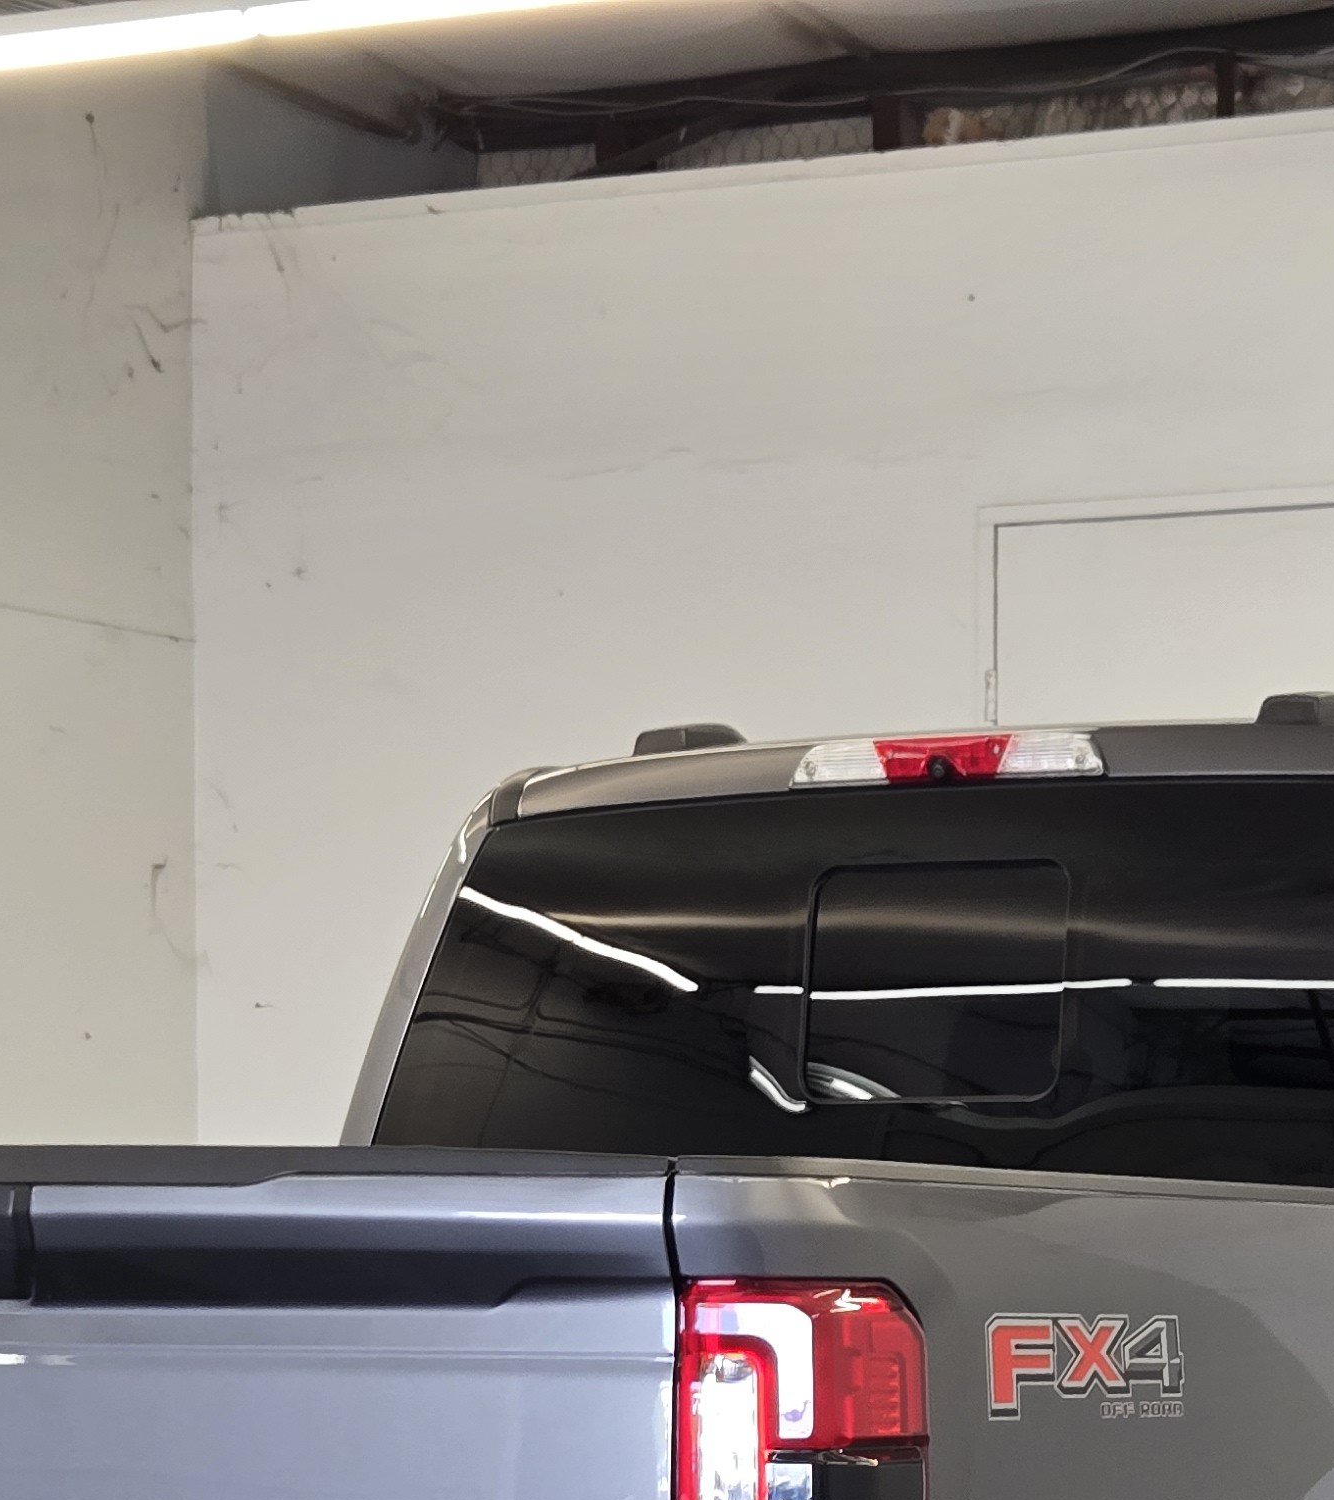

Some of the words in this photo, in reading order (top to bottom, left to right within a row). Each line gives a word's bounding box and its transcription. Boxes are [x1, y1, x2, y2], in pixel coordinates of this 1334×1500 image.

[985, 1312, 1185, 1421] FX4
[1100, 1401, 1136, 1419] OFF
[1139, 1401, 1184, 1419] ROAD
